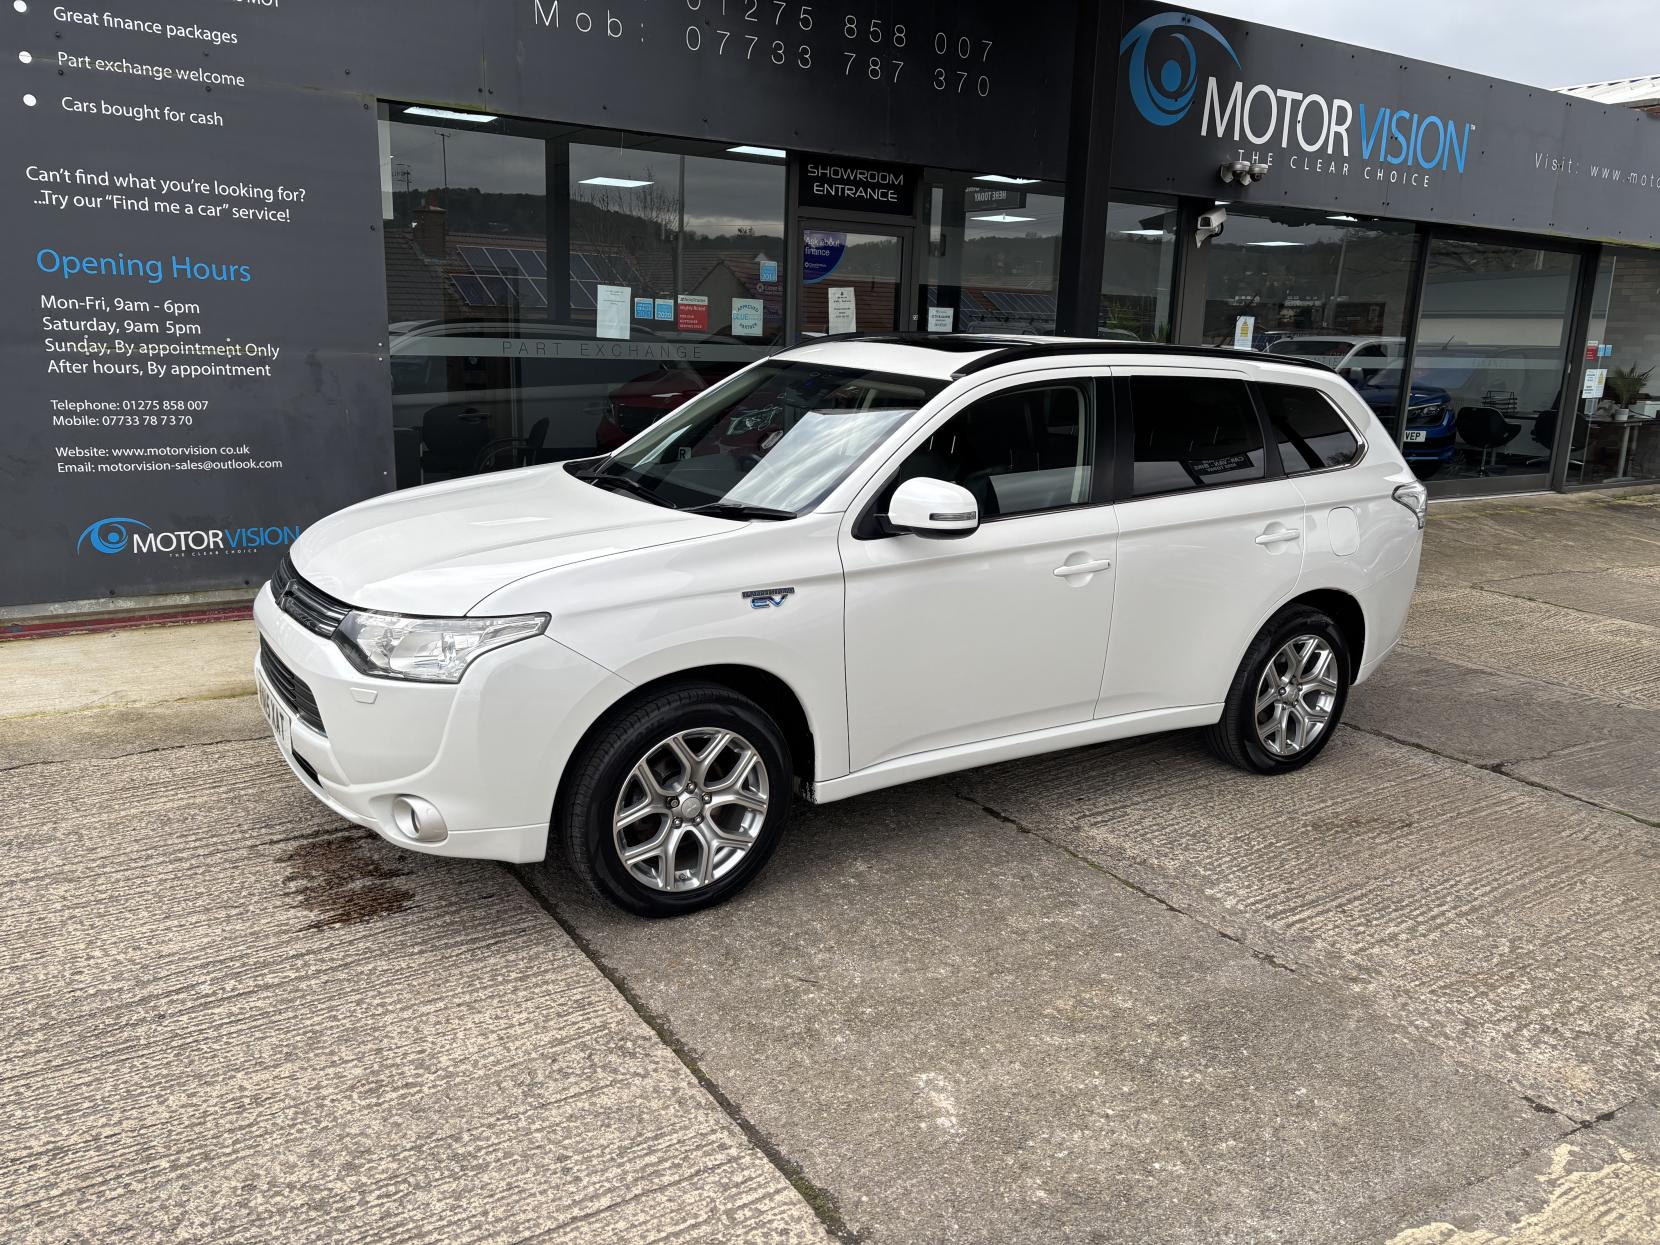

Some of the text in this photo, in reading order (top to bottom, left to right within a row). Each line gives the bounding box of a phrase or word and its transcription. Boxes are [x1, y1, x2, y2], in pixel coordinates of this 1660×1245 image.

[53, 6, 238, 44] Great finance packages
[534, 0, 989, 96] Mob: 07733 787 370
[844, 16, 906, 47] 858
[935, 32, 992, 62] 007
[58, 52, 245, 86] Part exchange welcome
[61, 97, 223, 126] Cars bought for cash
[1238, 150, 1430, 187] THE CLEAR CHOICE
[1535, 152, 1579, 174] Visit:
[75, 169, 109, 186] find
[114, 174, 156, 190] what
[214, 180, 273, 202] looking
[277, 186, 306, 202] for?
[808, 164, 904, 185] SHOWROOM
[814, 183, 898, 201] ENTRANCE
[74, 196, 103, 208] our
[154, 201, 180, 214] me
[185, 205, 193, 214] a
[232, 207, 290, 223] service!
[36, 249, 251, 284] Opening Hours
[41, 294, 110, 312] Mon-Fri,
[114, 297, 150, 312] 9am
[164, 300, 200, 315] 6pm
[43, 317, 201, 336] Saturday, 9am 5pm
[45, 336, 280, 359] Sunday, By appointment Only
[502, 341, 702, 359] PART EXCHANGE
[48, 359, 271, 378] After hours, By appointment
[50, 400, 208, 412] Telephone: 01275 858 007
[53, 416, 99, 426] Mobile:
[102, 416, 140, 426] 07733
[56, 447, 108, 457] Website:
[57, 459, 282, 473] Email: motorvision-sales@outlook.com
